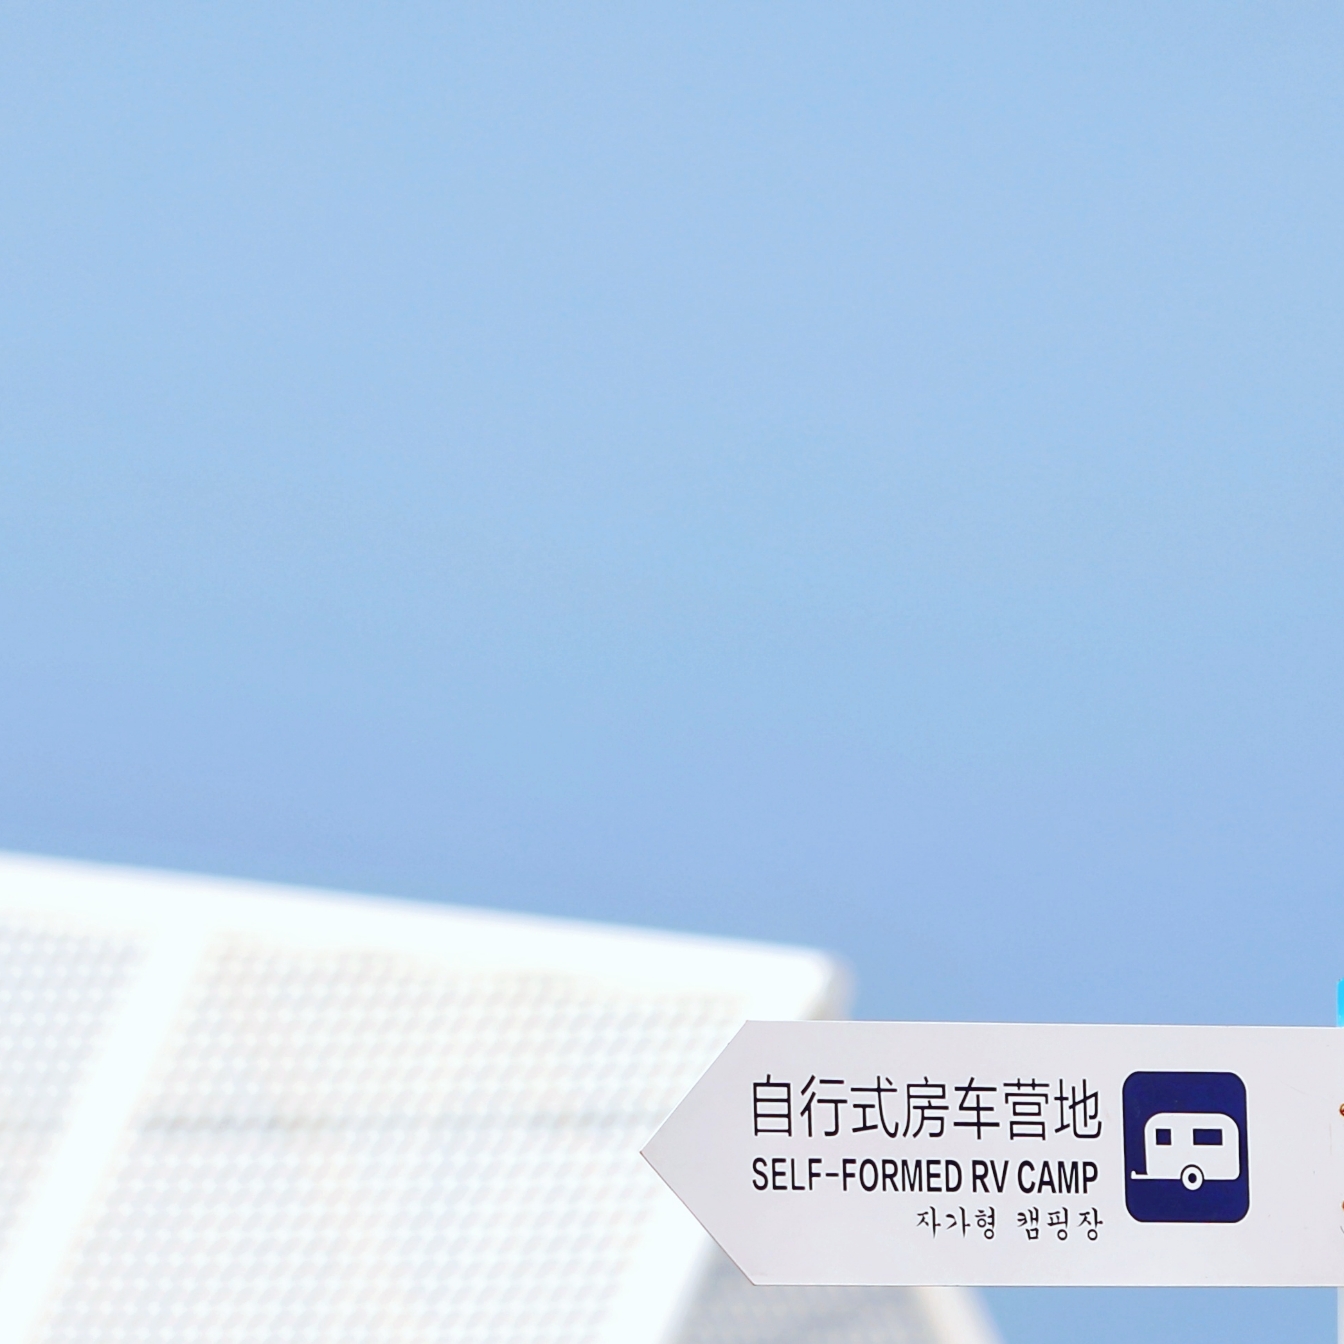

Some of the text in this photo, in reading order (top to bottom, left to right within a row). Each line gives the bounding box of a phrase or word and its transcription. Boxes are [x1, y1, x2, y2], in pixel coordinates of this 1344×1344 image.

[752, 1073, 1102, 1141] 自行式房车营地
[752, 1157, 1099, 1194] SELF-FORMED RV CAMP
[916, 1206, 1103, 1241] 자가형 캠핑장
